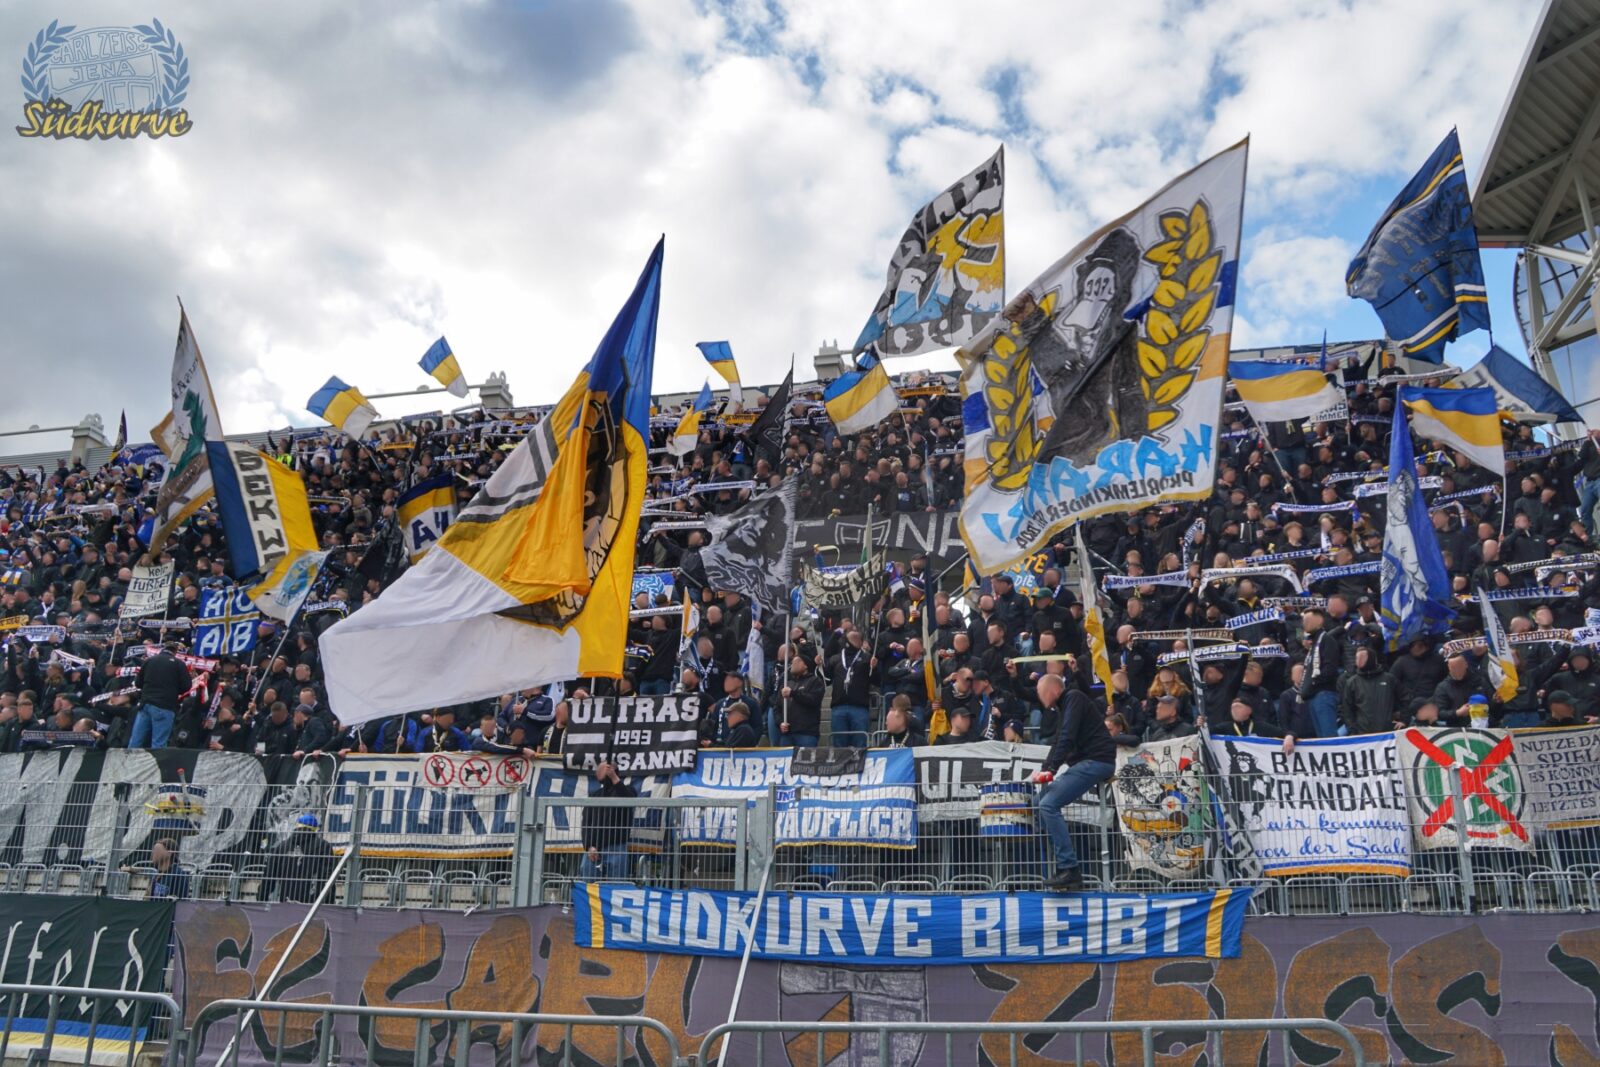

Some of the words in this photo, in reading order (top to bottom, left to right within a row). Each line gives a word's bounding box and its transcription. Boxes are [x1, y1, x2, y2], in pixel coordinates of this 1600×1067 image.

[1313, 568, 1348, 579] SCHEISS
[571, 697, 700, 723] ULTRAS
[613, 730, 652, 745] 1993
[1520, 737, 1577, 753] NUTZE
[1271, 746, 1398, 779] BAMBULE
[1537, 747, 1599, 769] SPIEL
[1528, 771, 1545, 783] ES
[1277, 780, 1407, 811] RANDALE
[1532, 796, 1597, 813] LETZTES
[1318, 812, 1408, 834] kommen
[1255, 845, 1291, 858] von
[1300, 835, 1338, 857] der
[611, 888, 933, 958] SÜDKURVE
[962, 897, 1198, 957] BLEIBT
[816, 970, 887, 992] JENA
